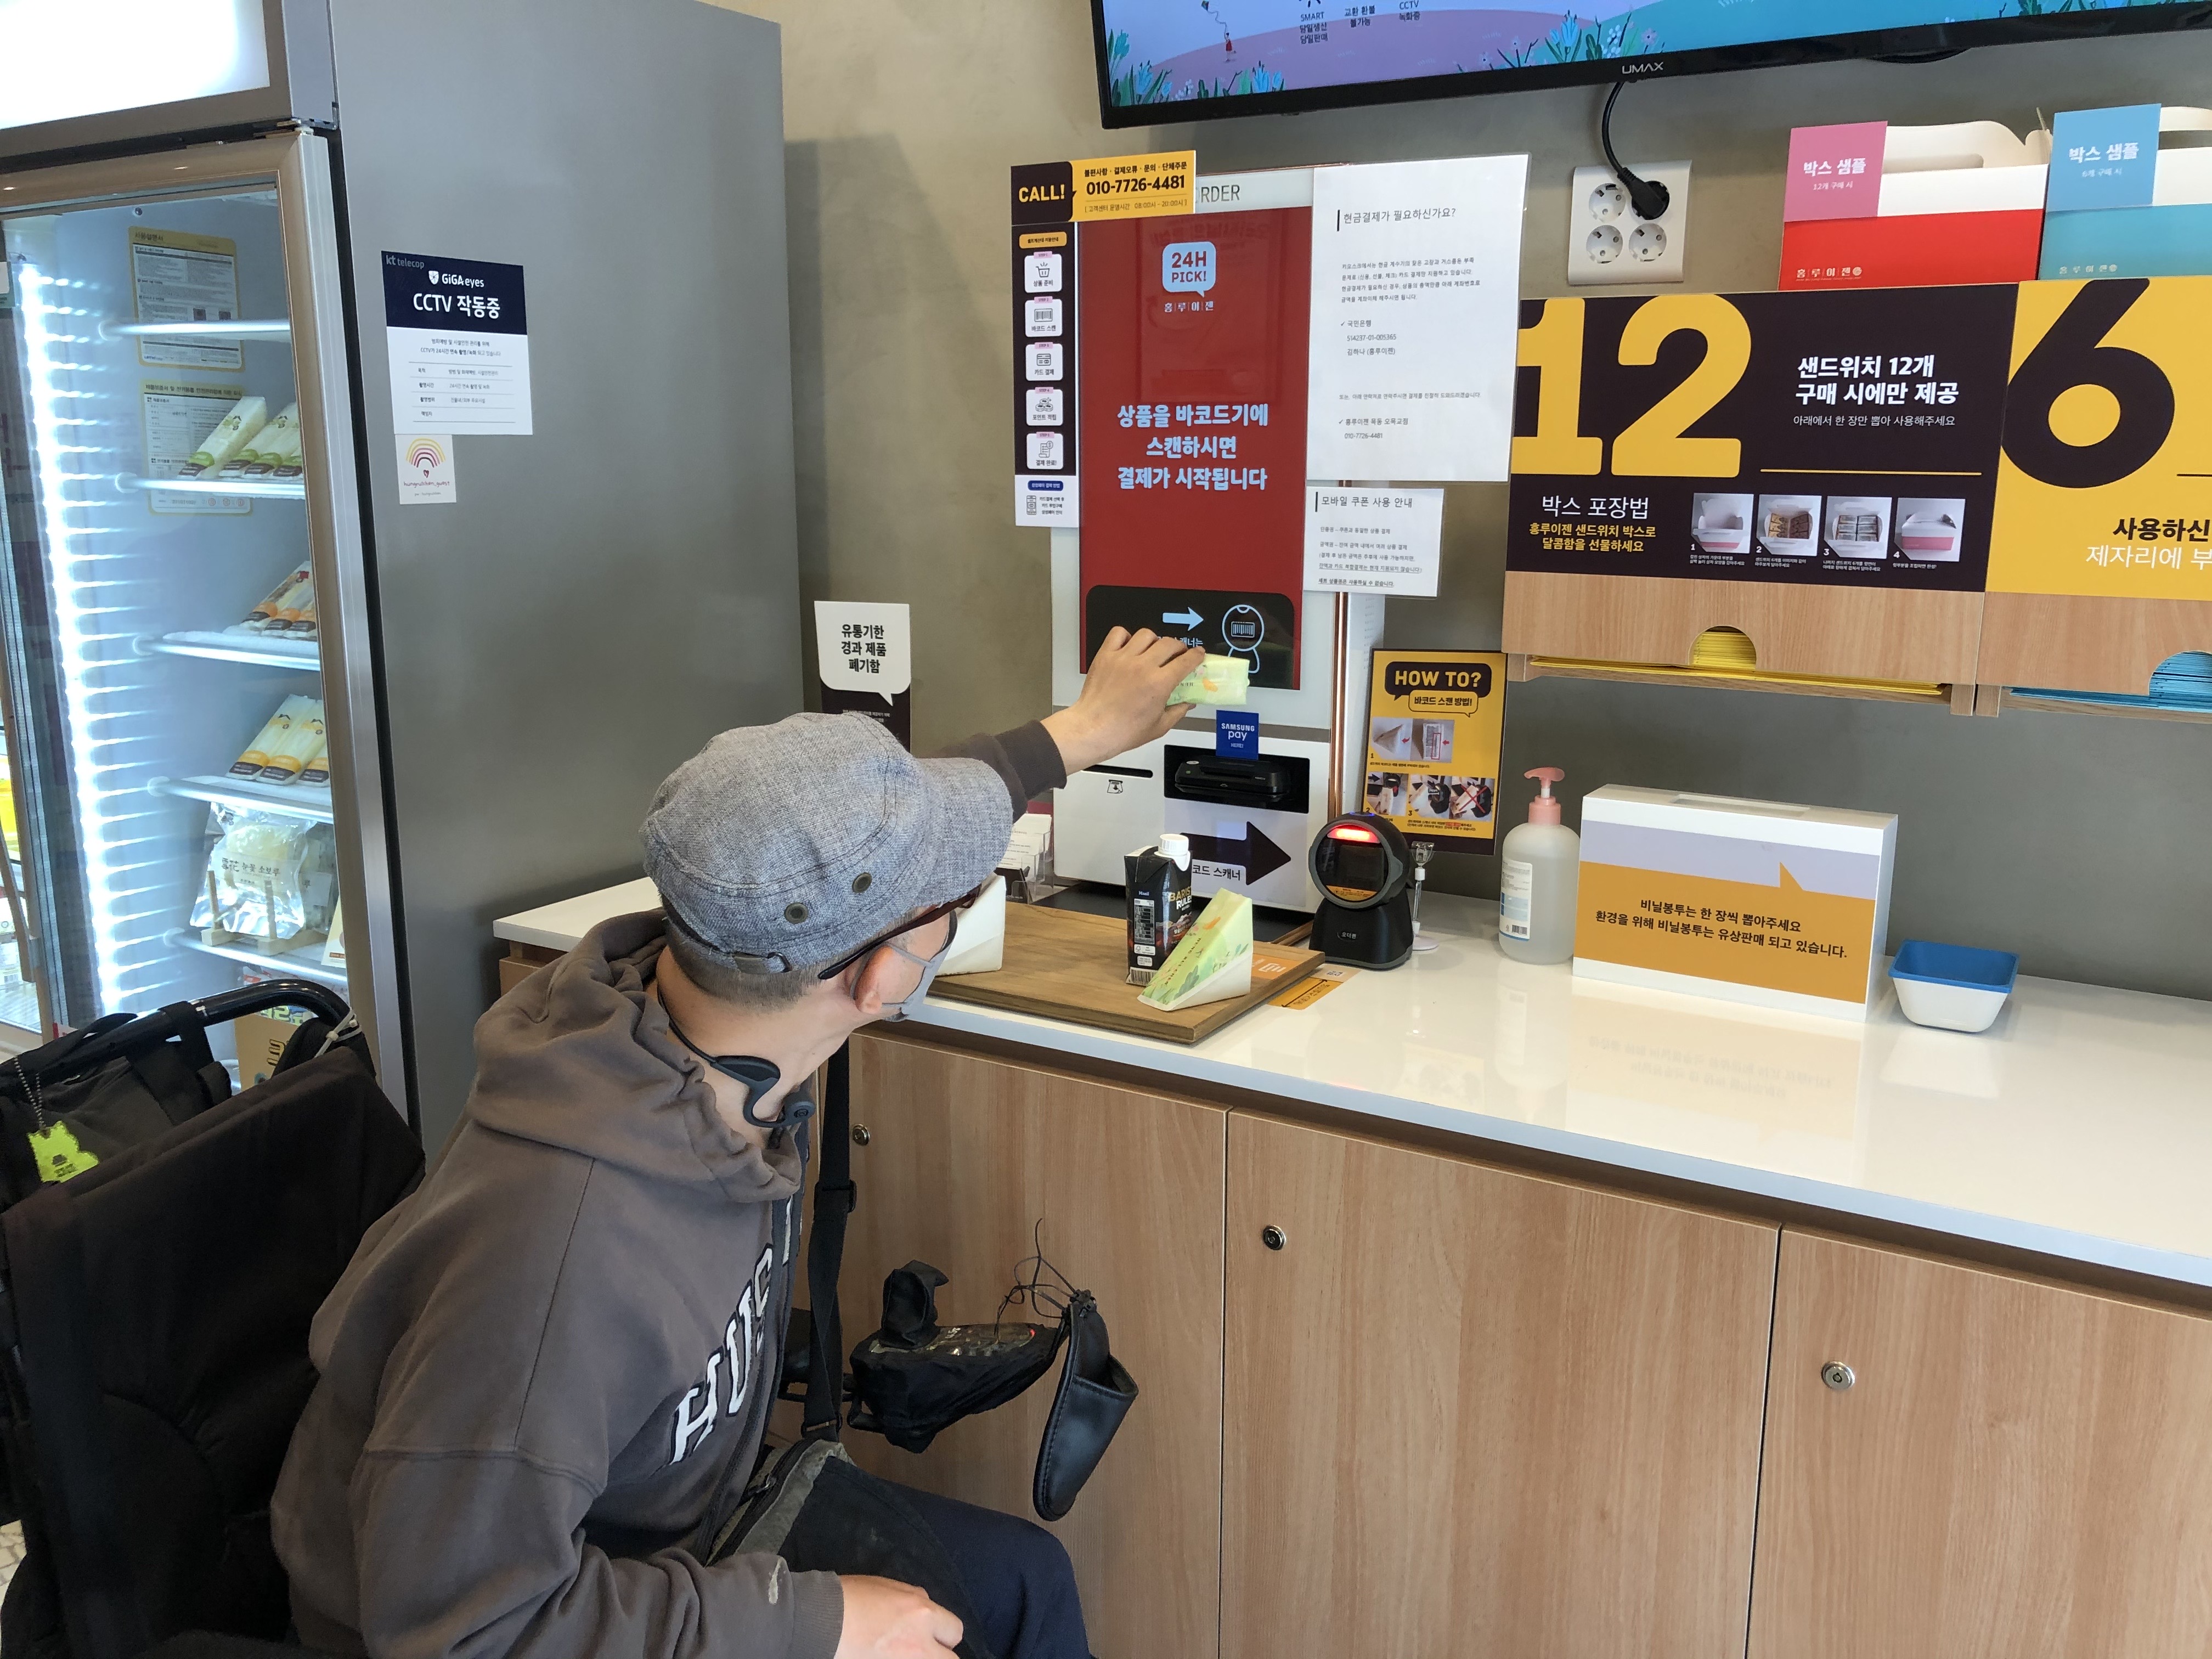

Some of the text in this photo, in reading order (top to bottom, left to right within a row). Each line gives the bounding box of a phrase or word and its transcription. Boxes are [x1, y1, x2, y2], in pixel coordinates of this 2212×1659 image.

[1345, 5, 1375, 16] 교환 환불
[1399, 0, 1419, 10] CCTV
[1300, 12, 1324, 21] SMART
[1350, 18, 1370, 27] 불가능
[1399, 11, 1420, 21] 녹화중
[1299, 22, 1327, 33] 당일생산
[1300, 33, 1328, 44] 당일판매
[1621, 61, 1664, 75] UMAX
[2069, 142, 2139, 163] 박스 샘플
[1114, 166, 1137, 175] 결제오류
[1143, 163, 1156, 172] 문의
[1162, 161, 1187, 171] 단체주문
[1803, 157, 1866, 177] 박스 샘플
[1019, 184, 1065, 203] CALL!
[1086, 175, 1185, 196] 010-7726-4481
[1813, 182, 1829, 190] 12개
[1197, 184, 1240, 204] RDER
[1344, 207, 1456, 224] 현금결제가 필요하신가요?
[386, 255, 425, 270] kt telecop
[1171, 250, 1207, 268] 24H
[1171, 270, 1206, 283] PICK!
[413, 293, 500, 319] CCTV 작동중
[1798, 354, 1935, 379] 샌드위치 12개
[1511, 294, 1751, 477] 12
[2001, 278, 2175, 489] 6
[1795, 382, 1959, 405] 구매 시에만 제공
[1117, 403, 1268, 428] 상품을 바코드기에
[1793, 415, 1956, 427] 아래에서 한 장만 뽑아 사용해주세요
[1146, 436, 1237, 459] 스캔하시면
[1118, 467, 1268, 490] 결제가 시작됩니다
[1321, 496, 1413, 508] 모바일 쿠폰 사용 안내
[1542, 495, 1649, 520] 박스 포장법
[1529, 522, 1656, 538] 홍루이젠 샌드위치 박스로
[2112, 516, 2211, 543] 사용하신
[1542, 537, 1644, 552] 달콤함을 선물하세요
[2085, 544, 2182, 570] 제자리에
[841, 624, 884, 640] 유통기한
[841, 641, 887, 657] 경과 제품
[849, 658, 881, 674] 폐기함
[1395, 670, 1482, 688] HOW TO?
[1414, 696, 1472, 707] 바코드 스캔 방법!
[1221, 723, 1255, 732] SAMSUNG
[1228, 731, 1248, 741] pay
[242, 862, 256, 873] 눈꽃
[258, 865, 281, 877] 소보루
[1193, 864, 1240, 881] 코드 스캐너
[1168, 885, 1191, 902] BARIS
[1640, 899, 1802, 933] 비닐봉투는 한 장씩 뽑아주세요
[1595, 910, 1848, 959] 환경을 위해 비닐봉투는 유상판매 되고 있습니다.
